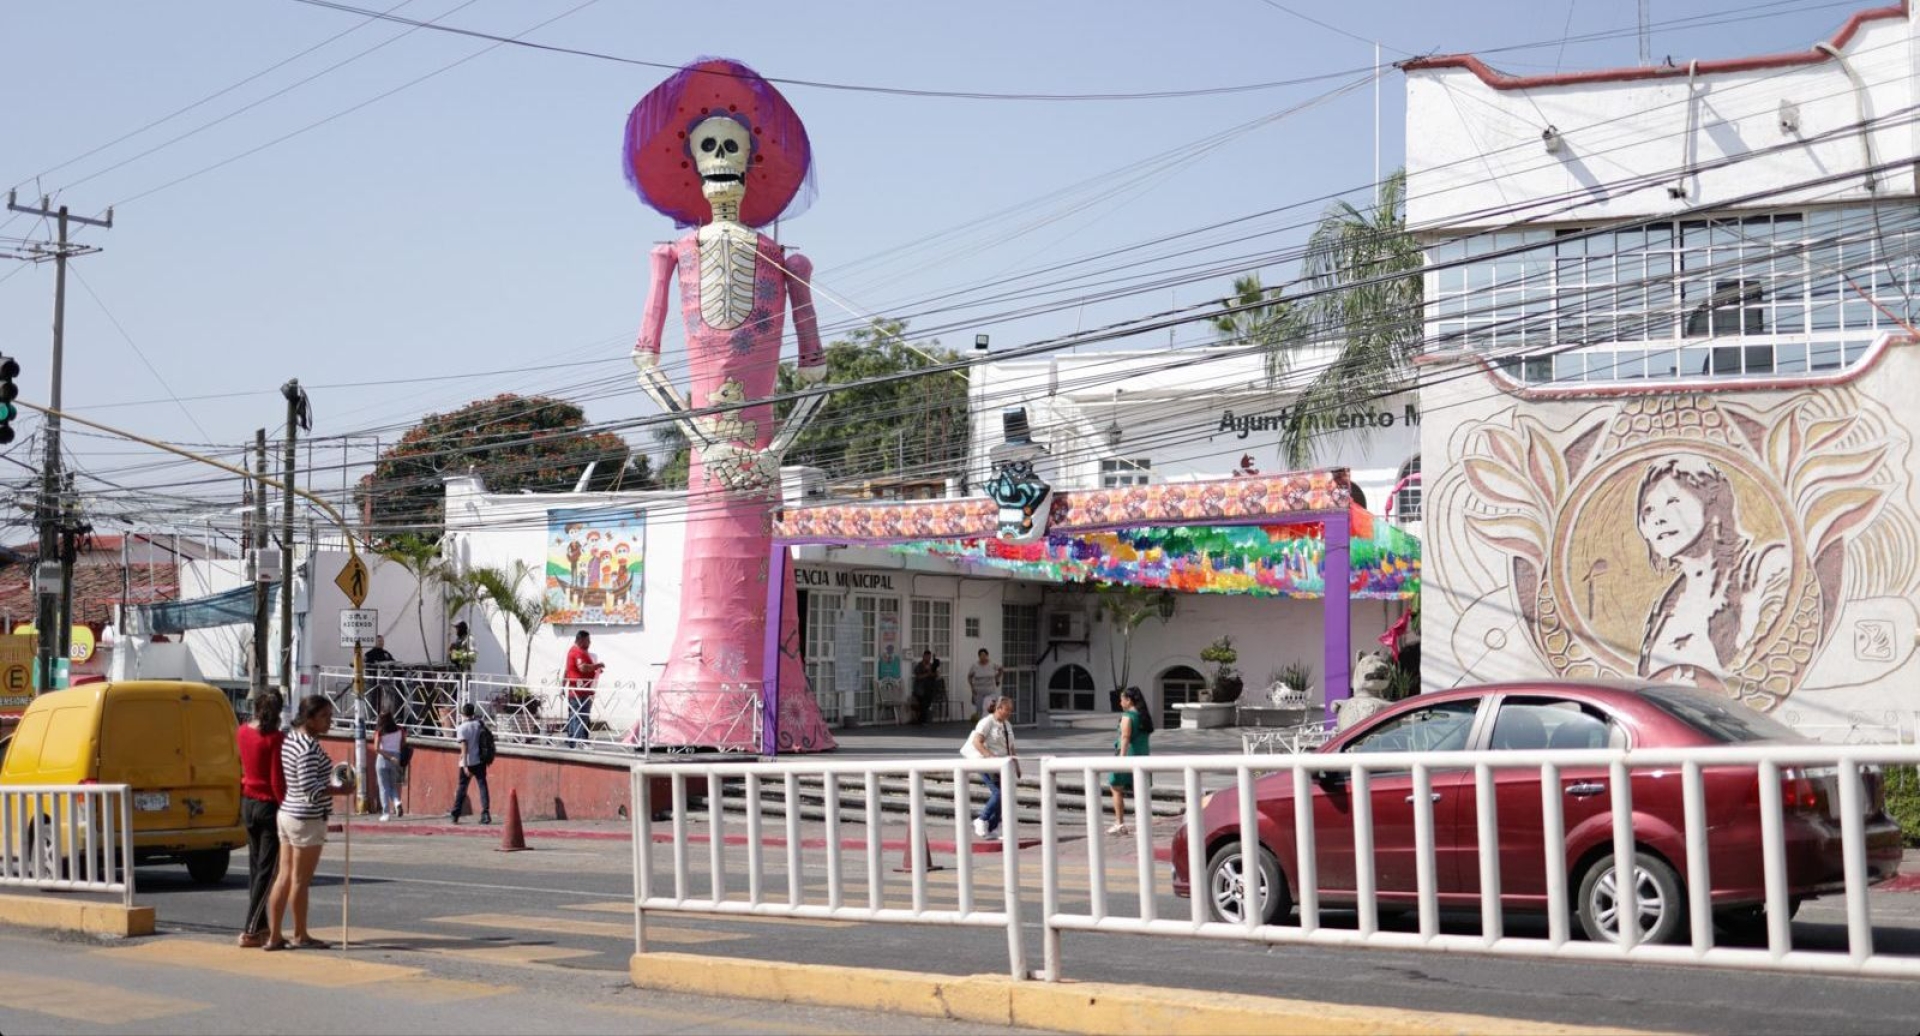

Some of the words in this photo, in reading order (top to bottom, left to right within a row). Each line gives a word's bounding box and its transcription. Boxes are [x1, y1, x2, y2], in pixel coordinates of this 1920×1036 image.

[1219, 409, 1394, 439] Ayuntmento
[835, 571, 894, 590] MUNICIPAL
[10, 669, 23, 689] E
